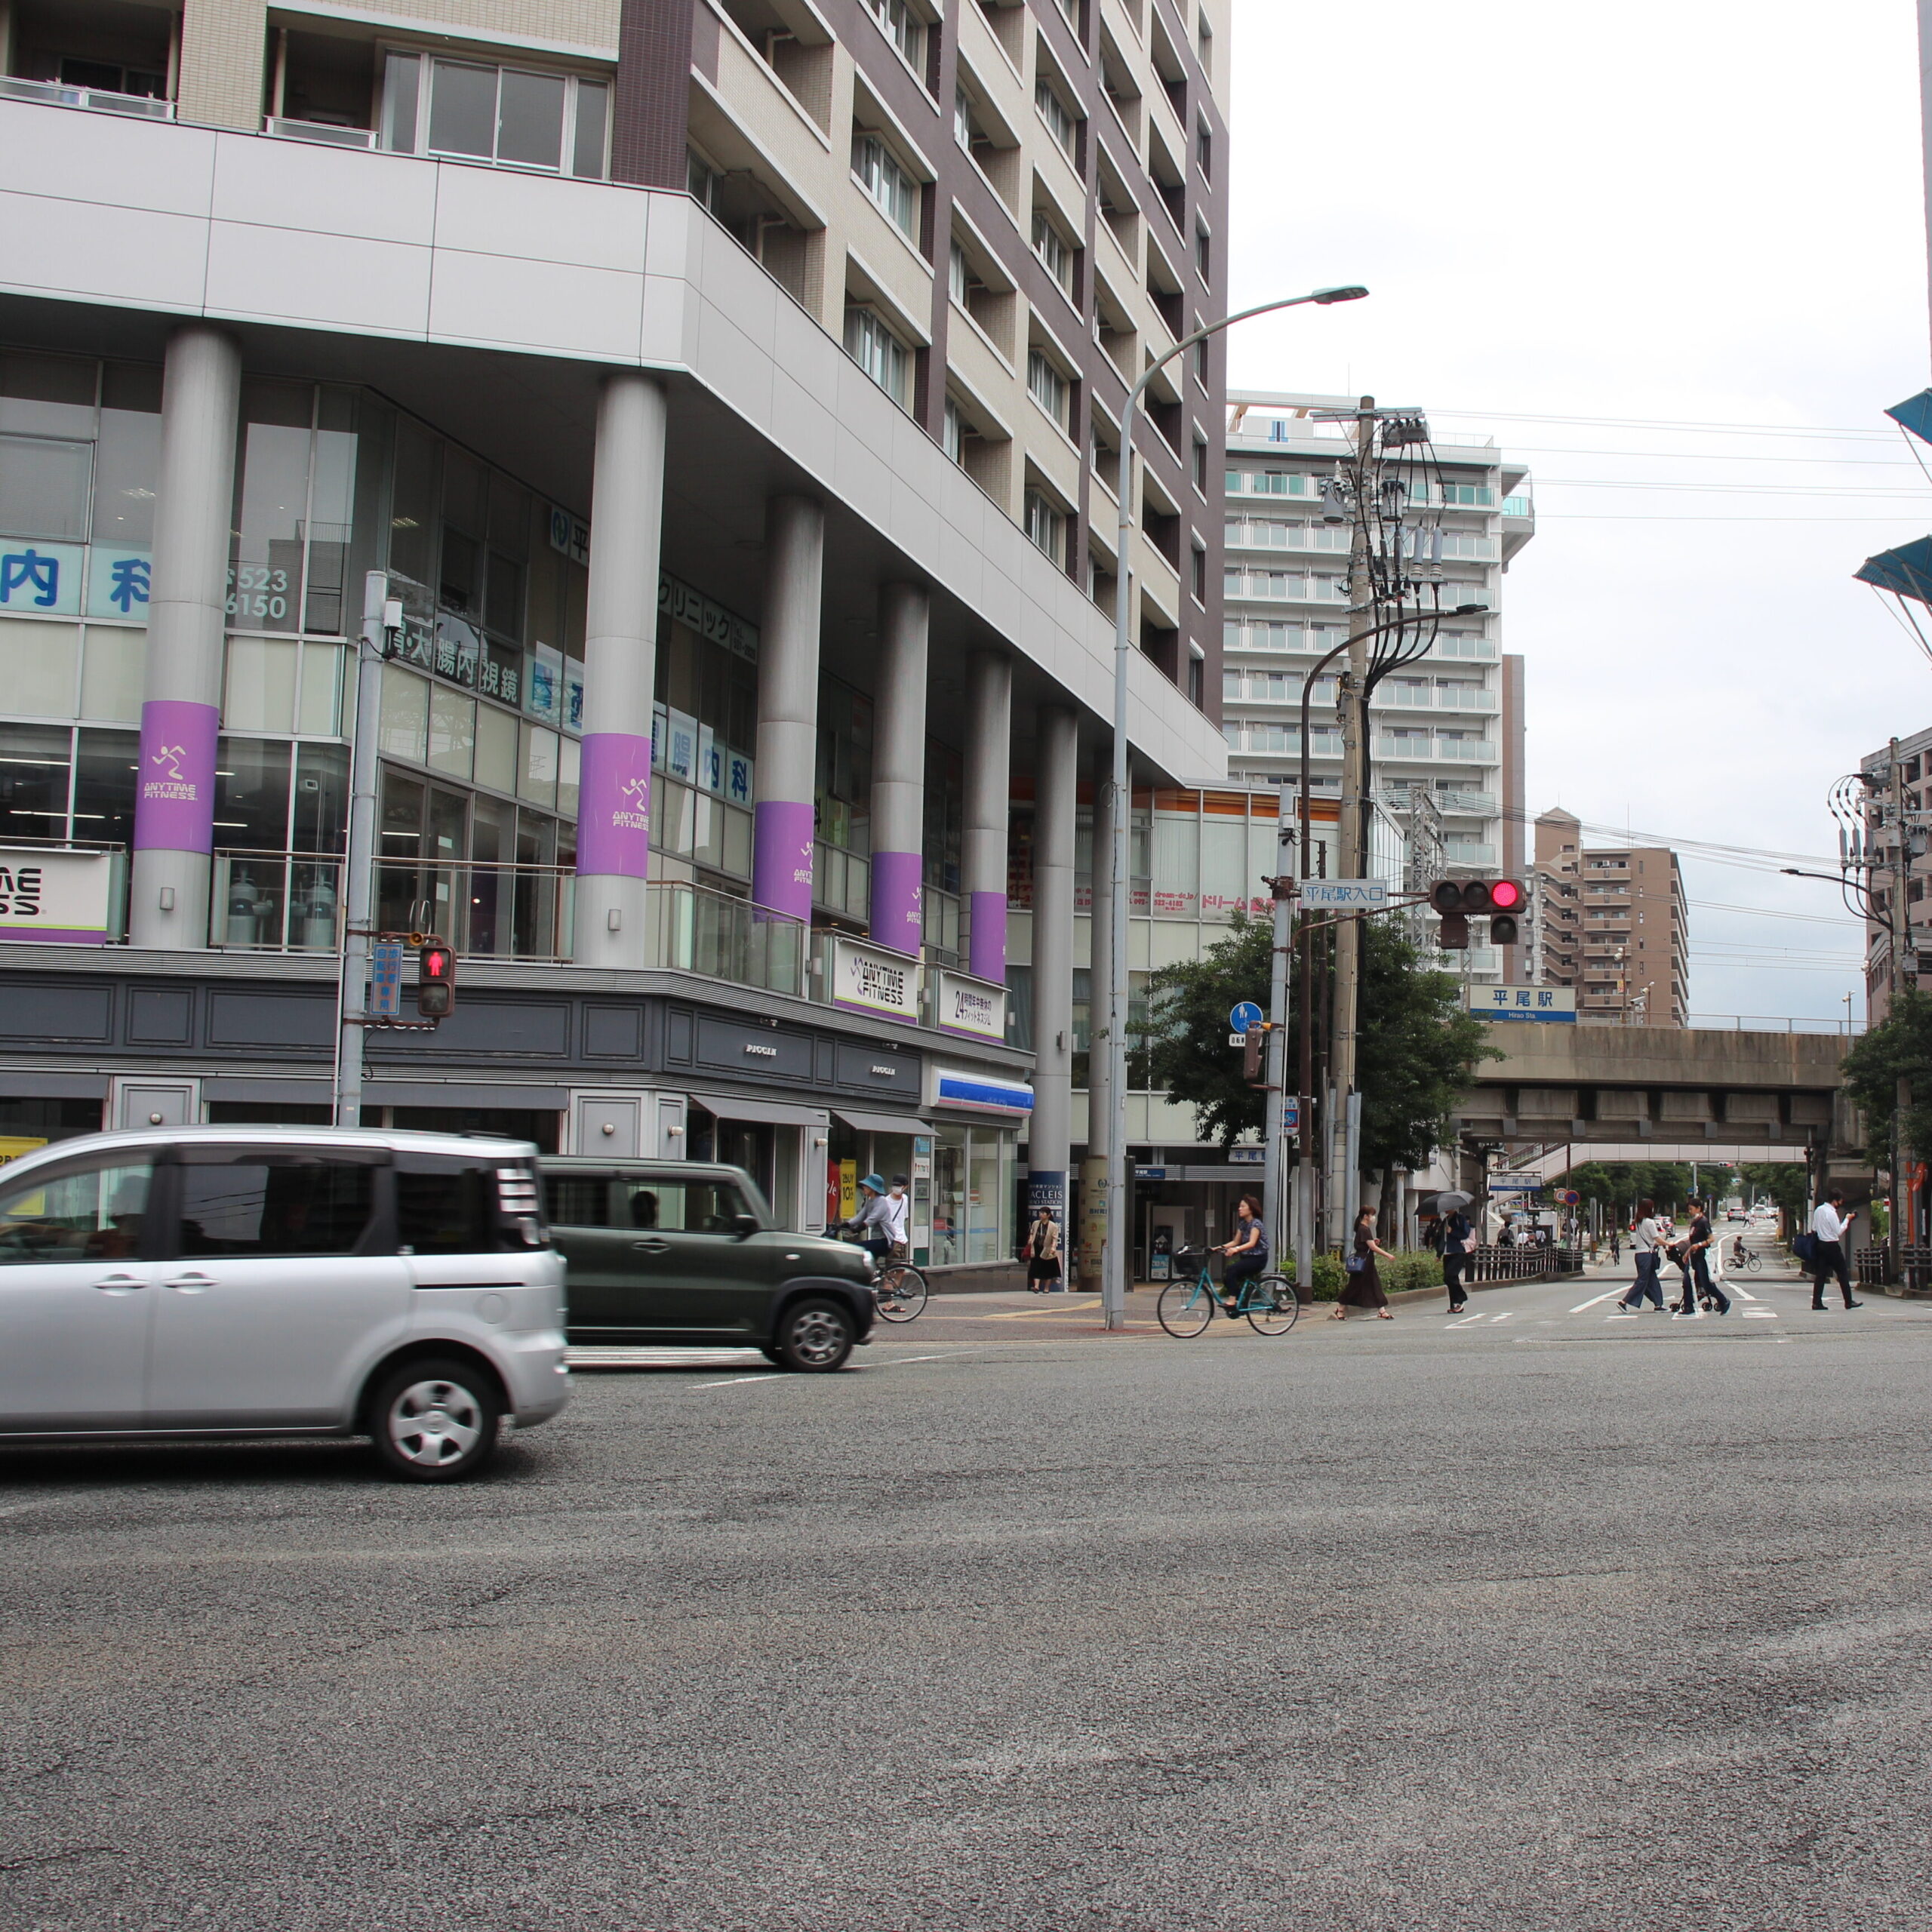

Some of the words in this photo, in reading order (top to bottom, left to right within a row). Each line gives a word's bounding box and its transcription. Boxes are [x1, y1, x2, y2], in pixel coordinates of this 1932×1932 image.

[238, 567, 288, 592] 523
[225, 592, 286, 619] 6150
[144, 782, 196, 793] ANYTIME
[144, 791, 196, 801] FITNESS
[1201, 894, 1246, 911] ドリーム
[1306, 887, 1383, 902] 平尾駅入口
[863, 961, 904, 990] ANYTIME
[863, 981, 903, 1006] FITNESS
[1492, 989, 1553, 1007] 平尾駅
[955, 989, 964, 1020] 24
